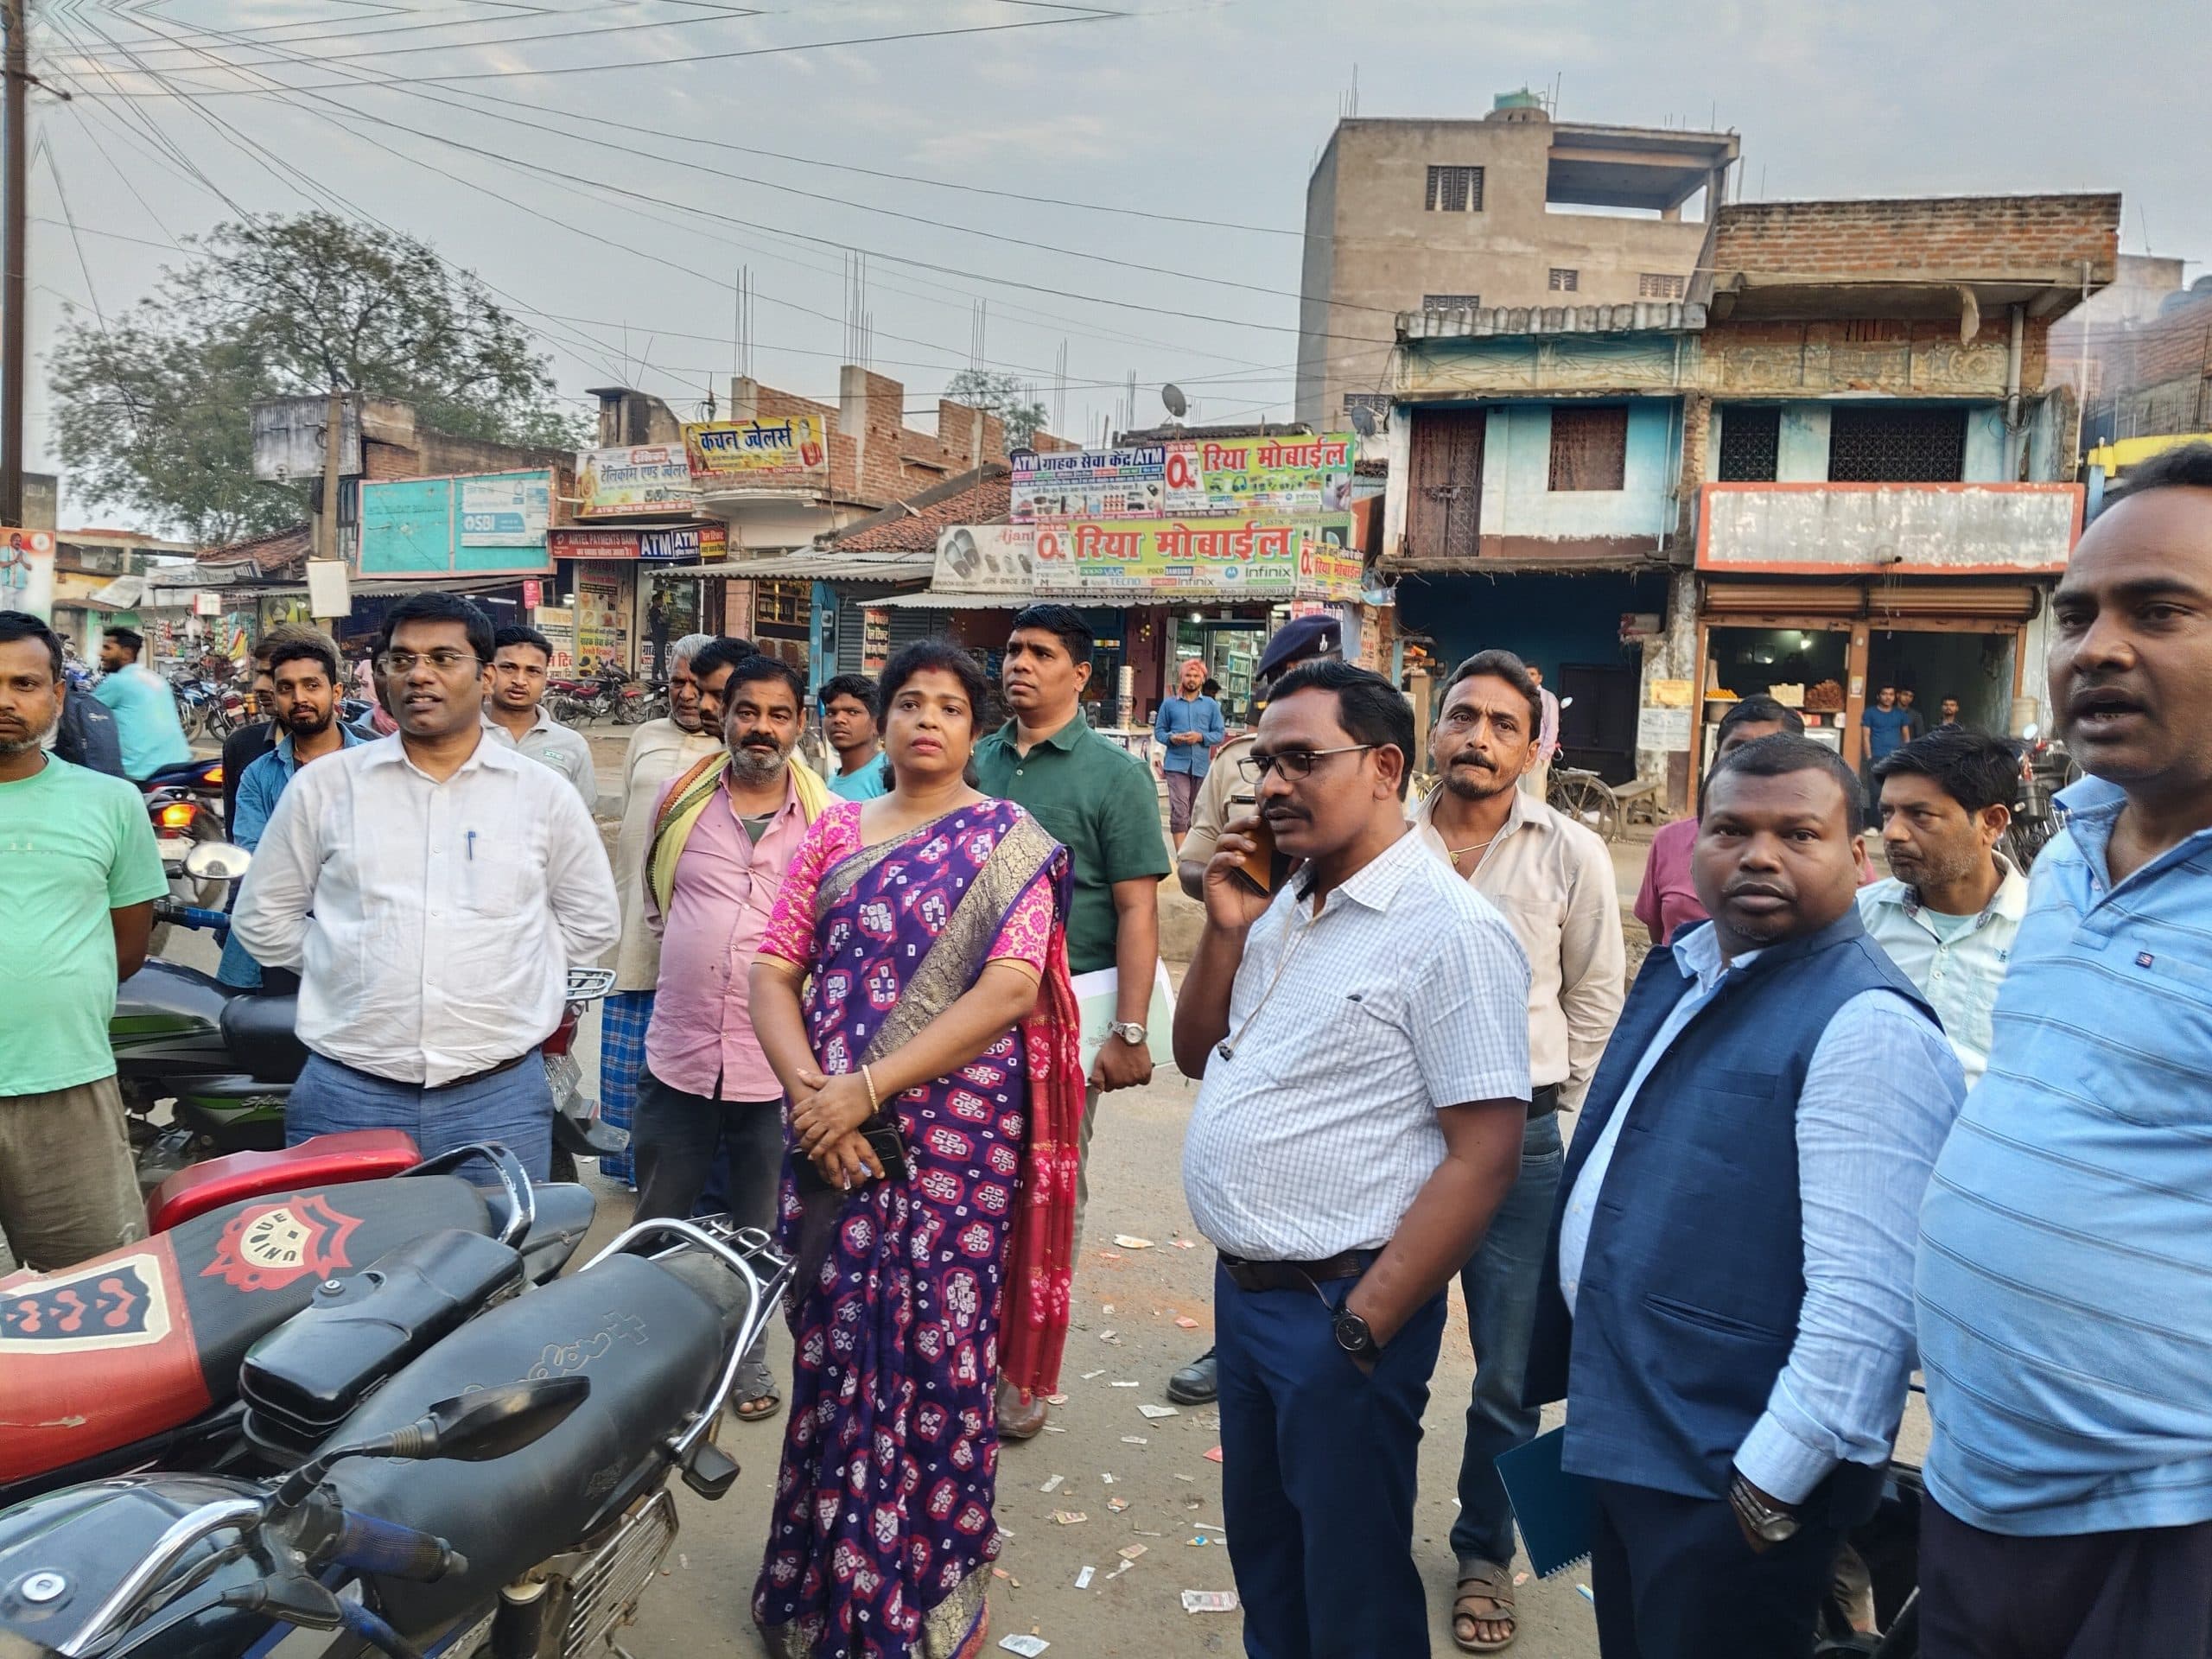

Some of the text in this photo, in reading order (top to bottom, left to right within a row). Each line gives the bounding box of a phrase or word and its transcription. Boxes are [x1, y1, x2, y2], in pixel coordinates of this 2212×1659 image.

[698, 420, 791, 451] कंचन ज्वेलर्स
[1082, 453, 1106, 468] सेवा
[1135, 448, 1163, 465] ATM
[1203, 437, 1348, 472] रिया मोबाईल
[1013, 456, 1038, 471] ATM
[476, 516, 495, 531] SBI
[569, 534, 639, 546] AIRTEL PAYMENTS BANK
[640, 534, 672, 555] ATM
[675, 532, 698, 548] ATM
[1074, 520, 1294, 561] रिया मोबाईल
[1245, 566, 1292, 578] Infinix
[1315, 558, 1362, 578] रिया मोबाईल
[1178, 577, 1214, 586] Infinix
[250, 1213, 296, 1262] UNIQUE
